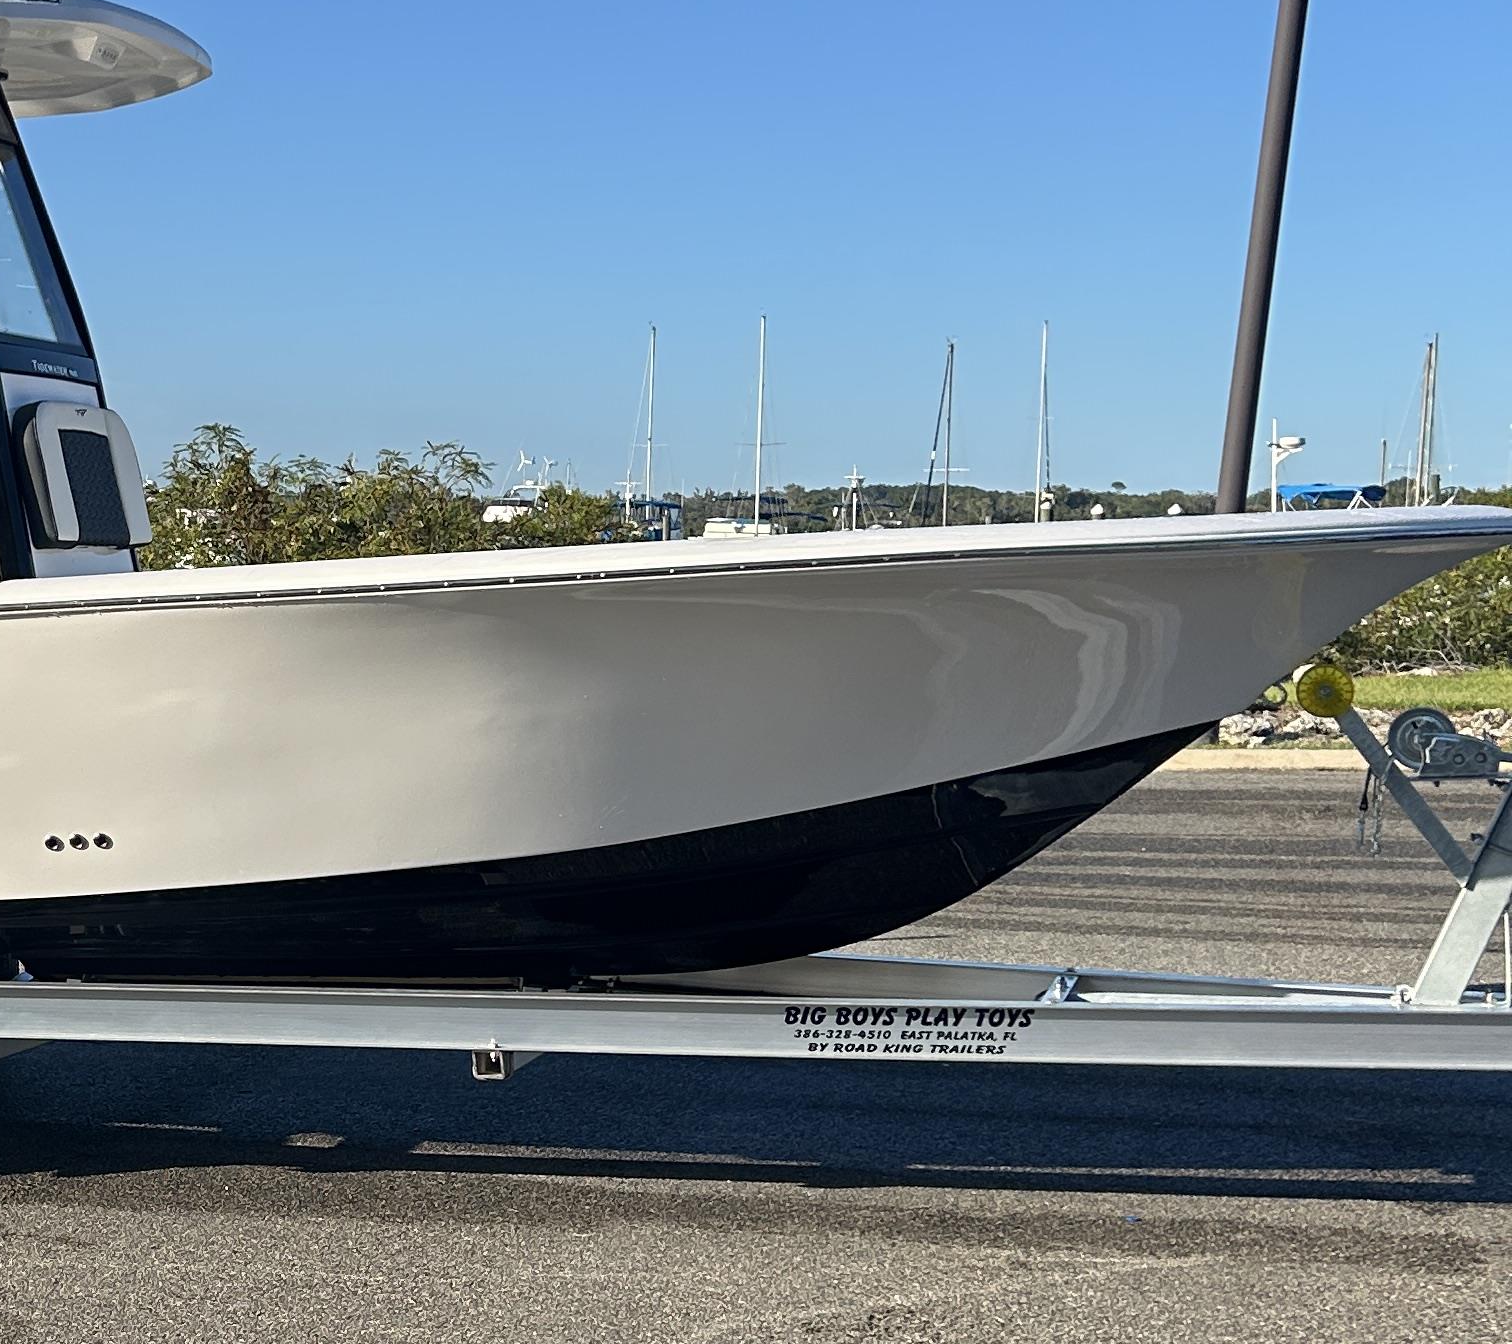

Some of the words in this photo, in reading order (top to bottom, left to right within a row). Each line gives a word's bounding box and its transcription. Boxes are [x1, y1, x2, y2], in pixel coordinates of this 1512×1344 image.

[784, 1006, 827, 1025] BIG
[835, 1007, 898, 1026] BOYS
[905, 1007, 967, 1027] PLAY
[974, 1008, 1035, 1028] TOYS
[793, 1029, 892, 1040] 386-328-4510
[900, 1030, 933, 1040] EAST
[936, 1031, 998, 1042] PALATKA,
[1002, 1031, 1018, 1041] FL
[807, 1042, 829, 1052] BY
[833, 1043, 878, 1053] ROAD
[882, 1044, 924, 1054] KING
[929, 1044, 1007, 1055] TRAILERS
